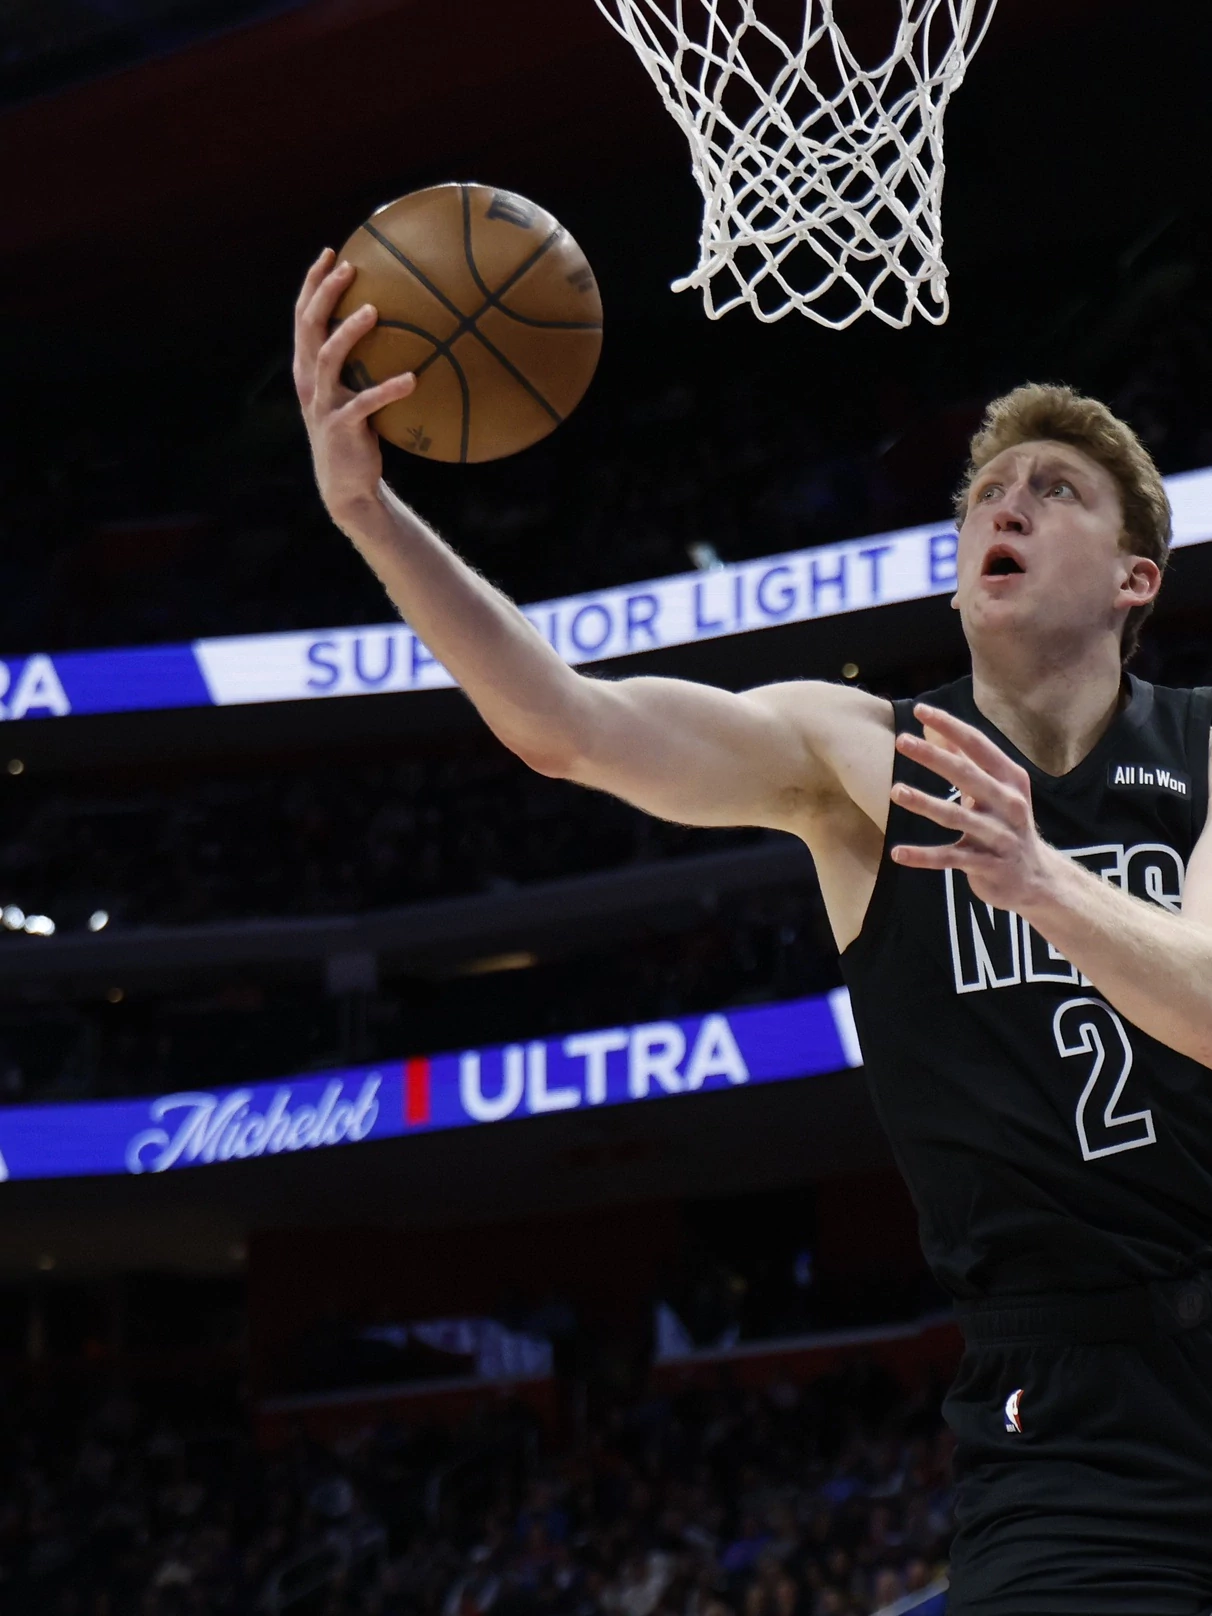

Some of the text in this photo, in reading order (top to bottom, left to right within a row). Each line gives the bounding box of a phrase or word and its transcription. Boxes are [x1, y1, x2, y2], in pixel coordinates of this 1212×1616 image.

[307, 594, 659, 690] SUPIOR
[694, 545, 893, 630] LIGHT
[1114, 766, 1186, 795] All In Won
[125, 1012, 750, 1175] Michelob ULTRA
[1053, 997, 1157, 1161] 2
